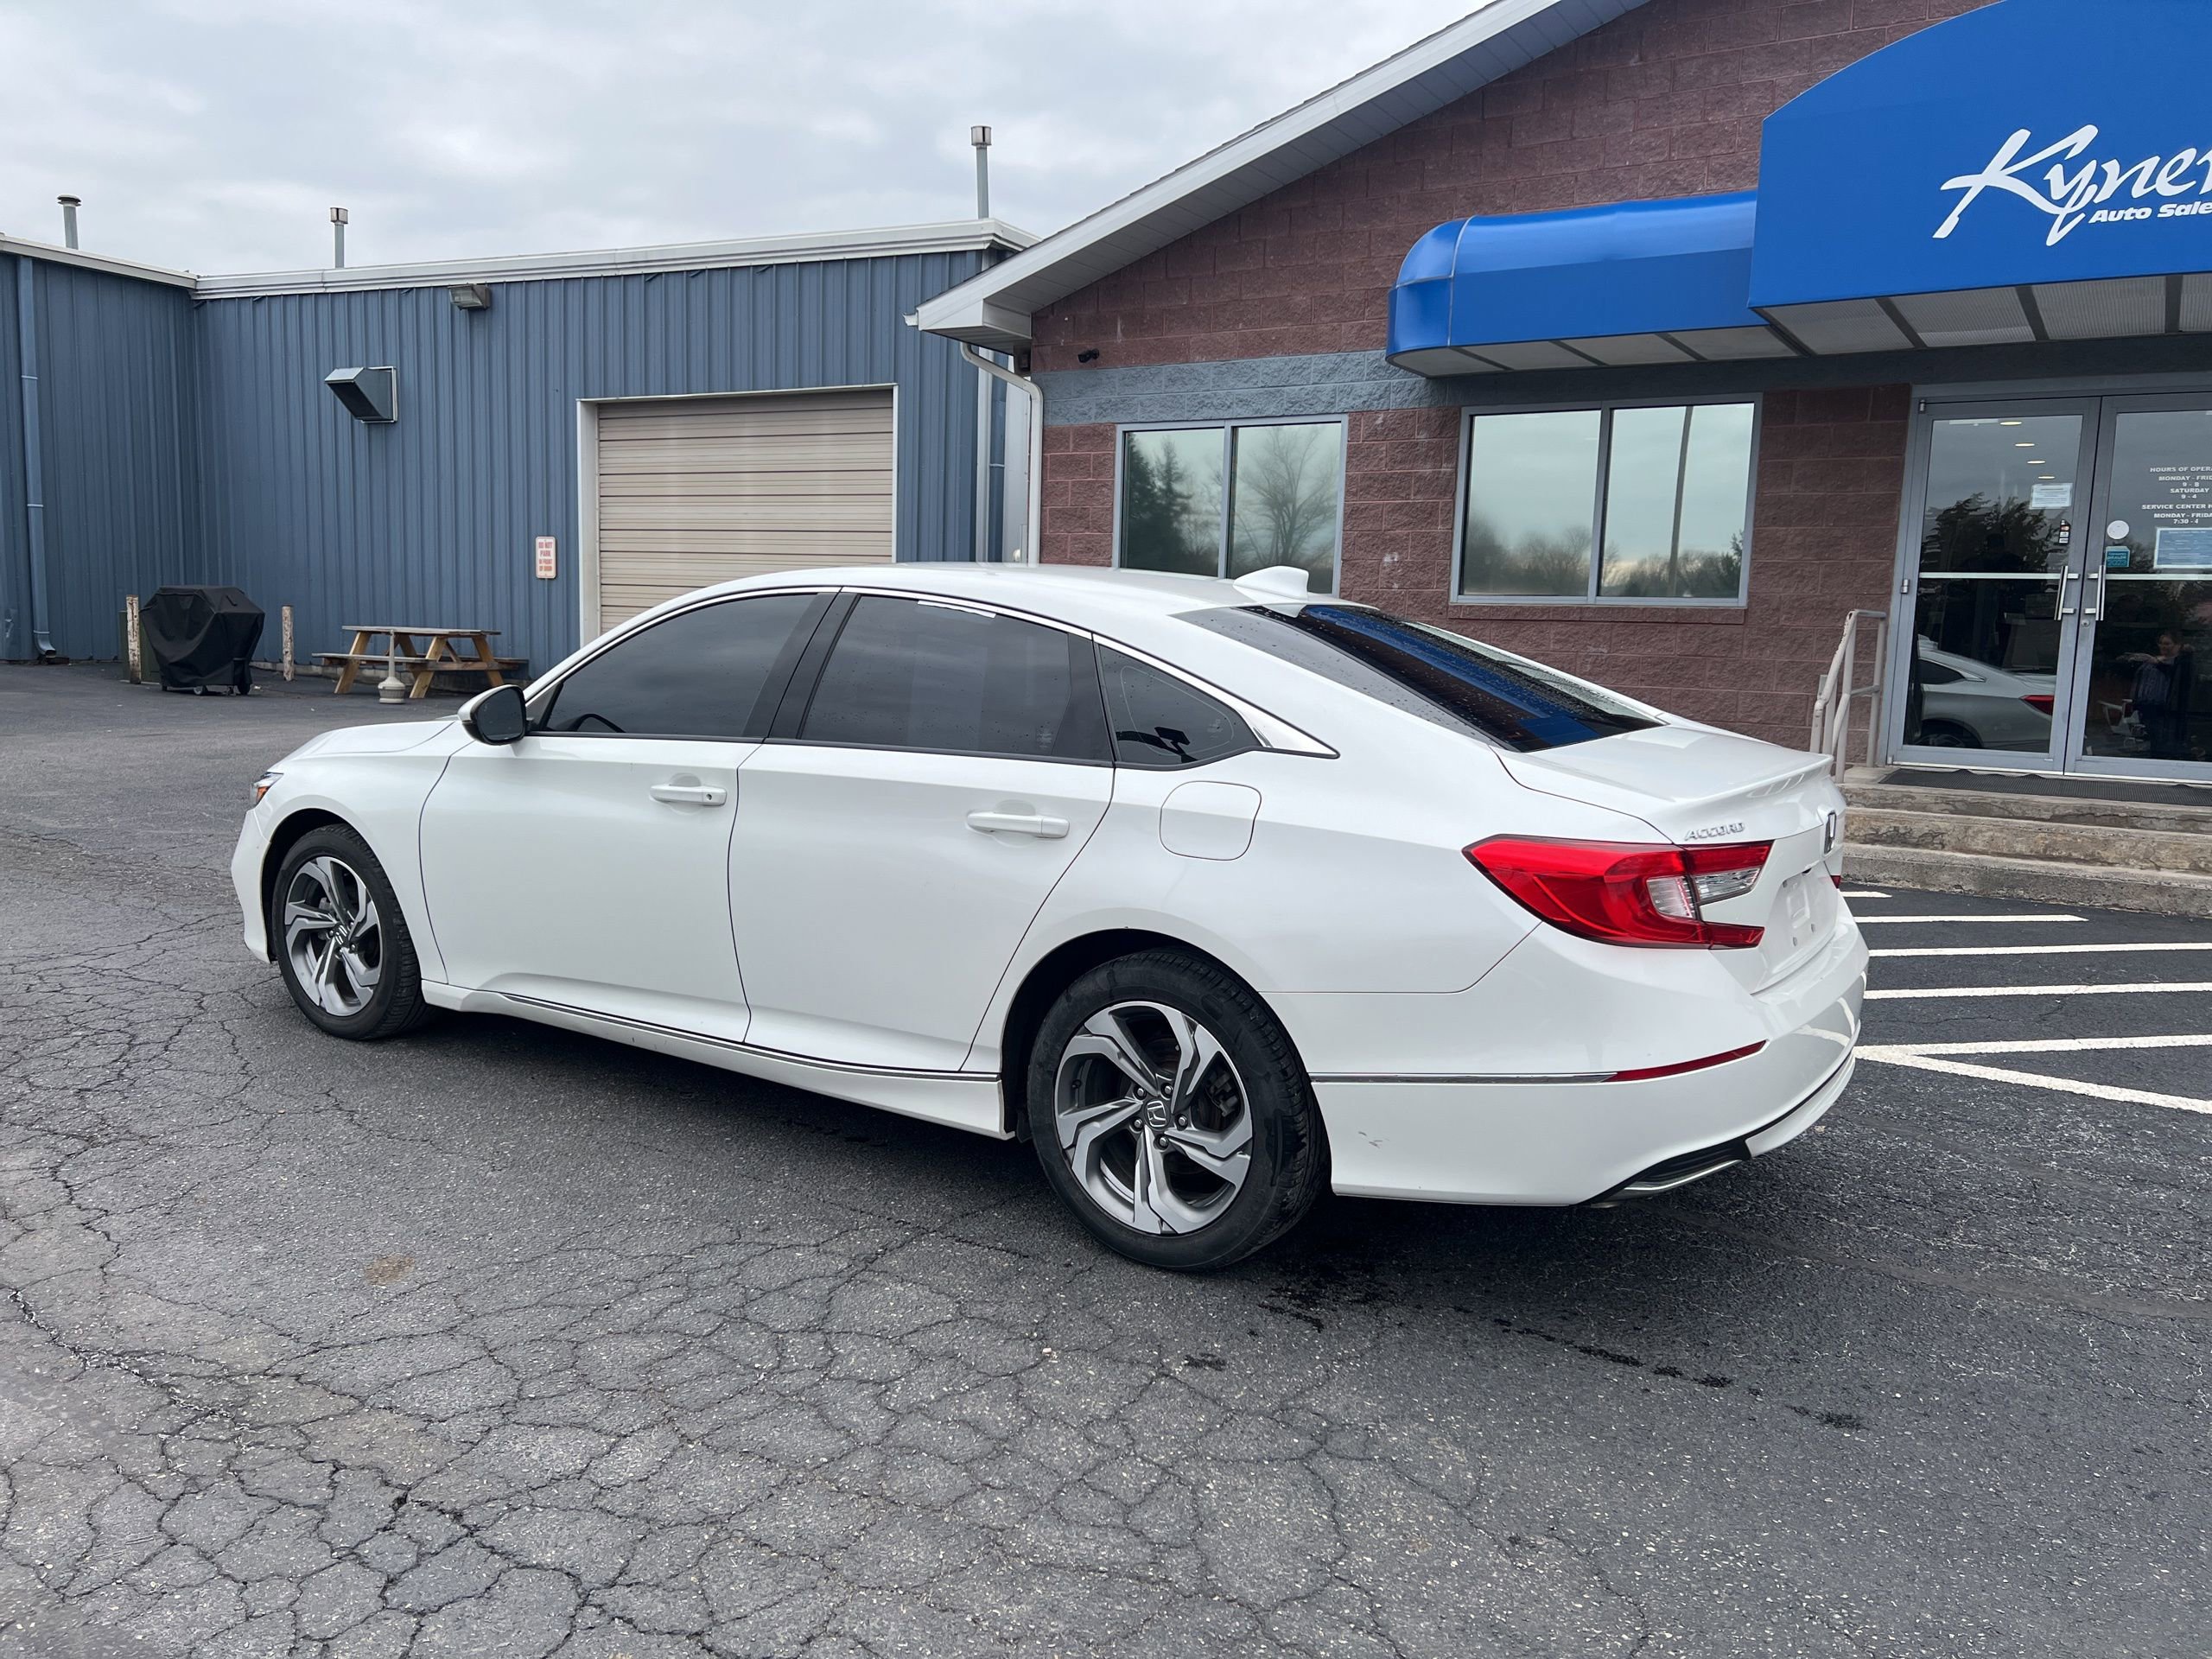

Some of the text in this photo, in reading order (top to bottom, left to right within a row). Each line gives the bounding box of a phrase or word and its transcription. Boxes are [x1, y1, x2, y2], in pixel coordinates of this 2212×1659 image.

[2088, 200, 2212, 224] Auto Sale
[1684, 822, 1745, 842] ACCORD
